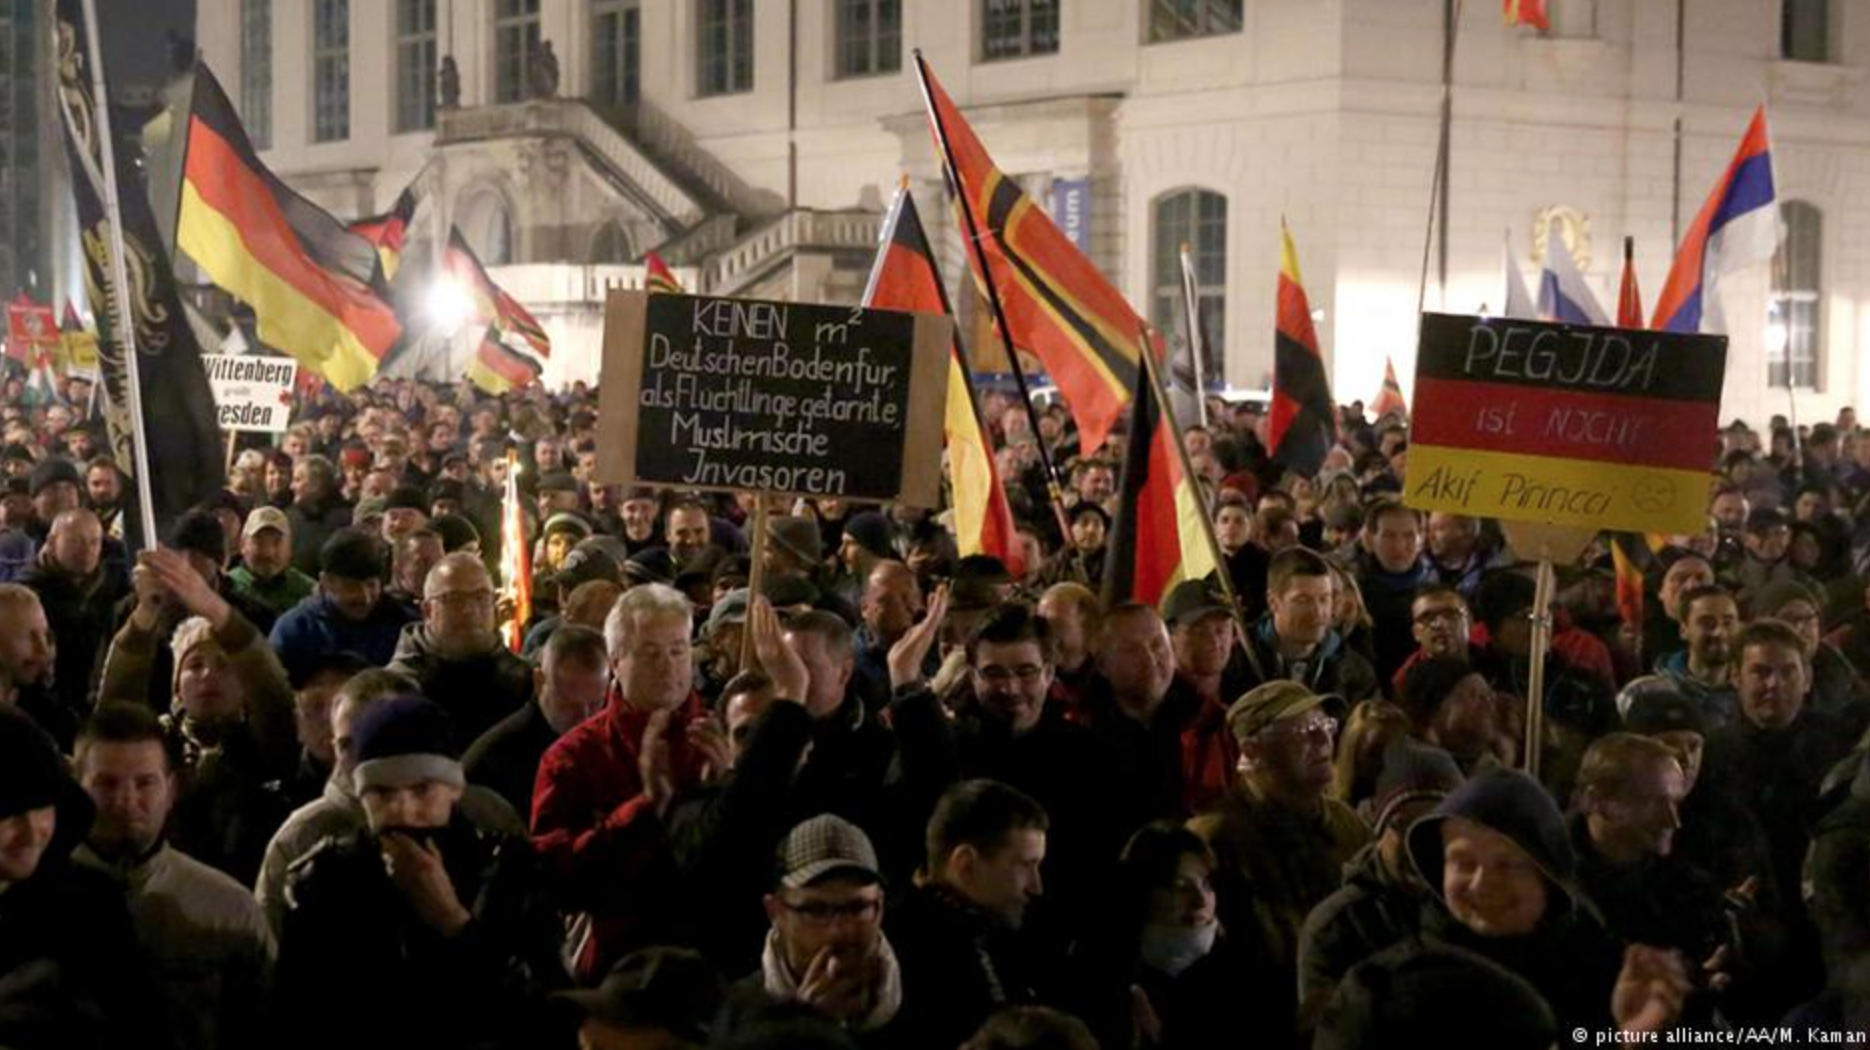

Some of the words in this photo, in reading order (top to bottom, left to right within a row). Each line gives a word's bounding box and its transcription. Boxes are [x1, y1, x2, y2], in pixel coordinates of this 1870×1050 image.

[692, 299, 788, 340] KEINEN
[671, 411, 829, 456] Muslimische
[1476, 402, 1519, 435] ist
[1414, 465, 1482, 509] Akif
